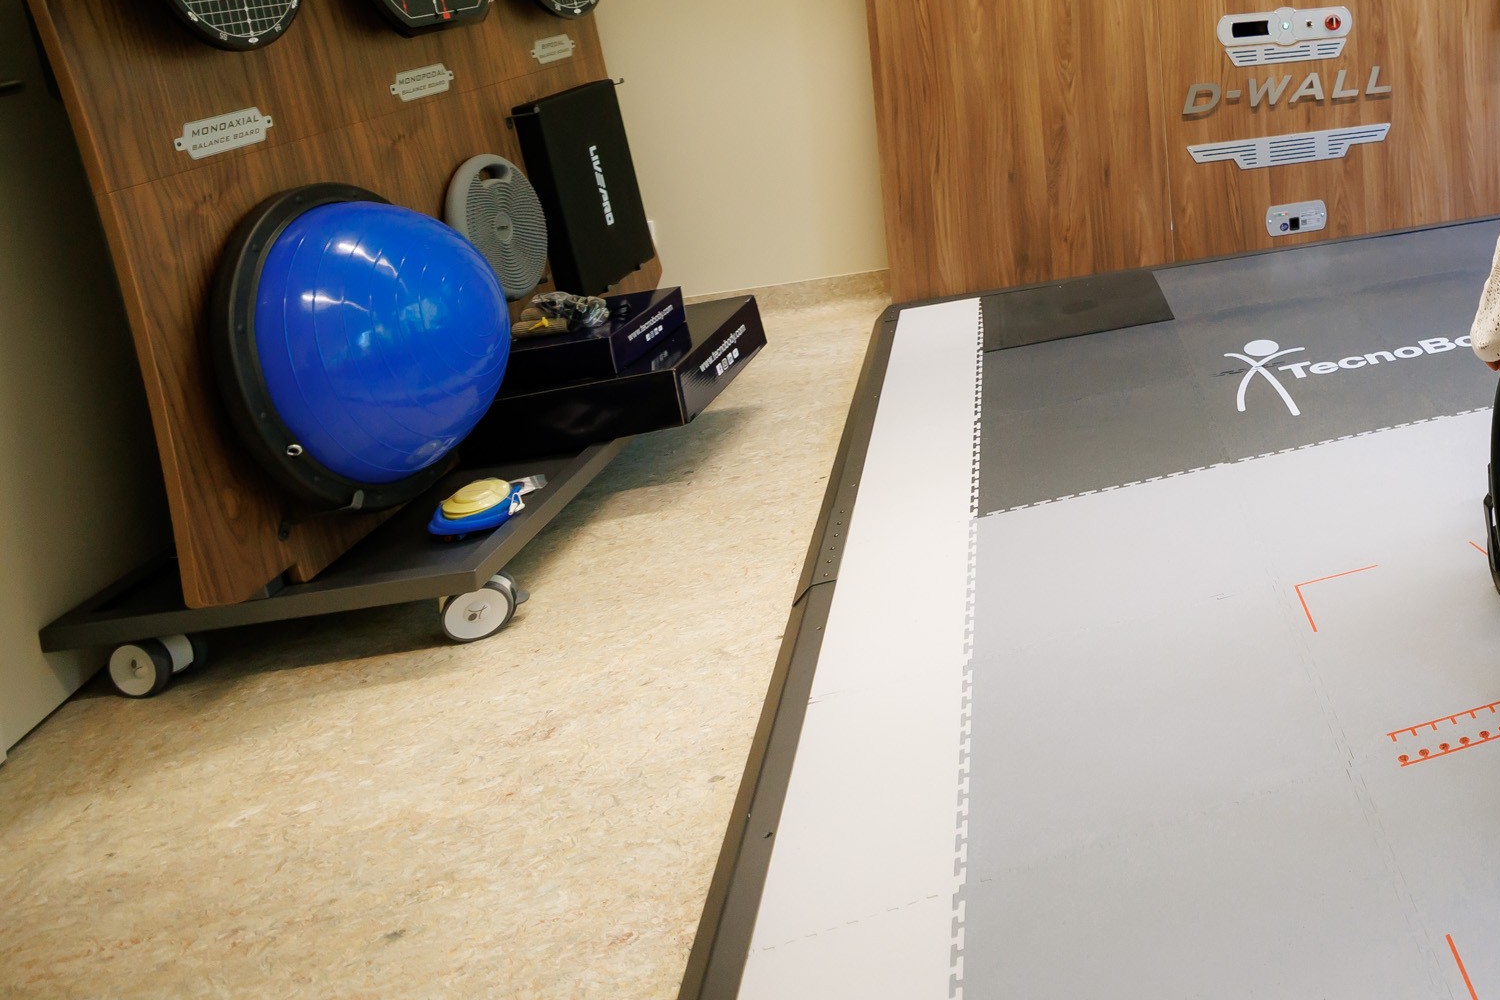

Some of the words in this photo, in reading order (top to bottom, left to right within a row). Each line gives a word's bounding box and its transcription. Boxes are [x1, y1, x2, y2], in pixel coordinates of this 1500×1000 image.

[398, 68, 446, 86] MONOPODAL
[401, 85, 427, 96] BALANCE
[427, 79, 446, 89] BOARD
[1182, 66, 1393, 116] D-WALL
[191, 114, 260, 138] MONOAXIAL
[191, 135, 231, 151] BALANCE
[233, 127, 260, 140] BOARD
[627, 304, 674, 341] www.tecnobody.com
[699, 323, 747, 373] www.tecnobody.com
[1277, 334, 1474, 379] TecnoBo
